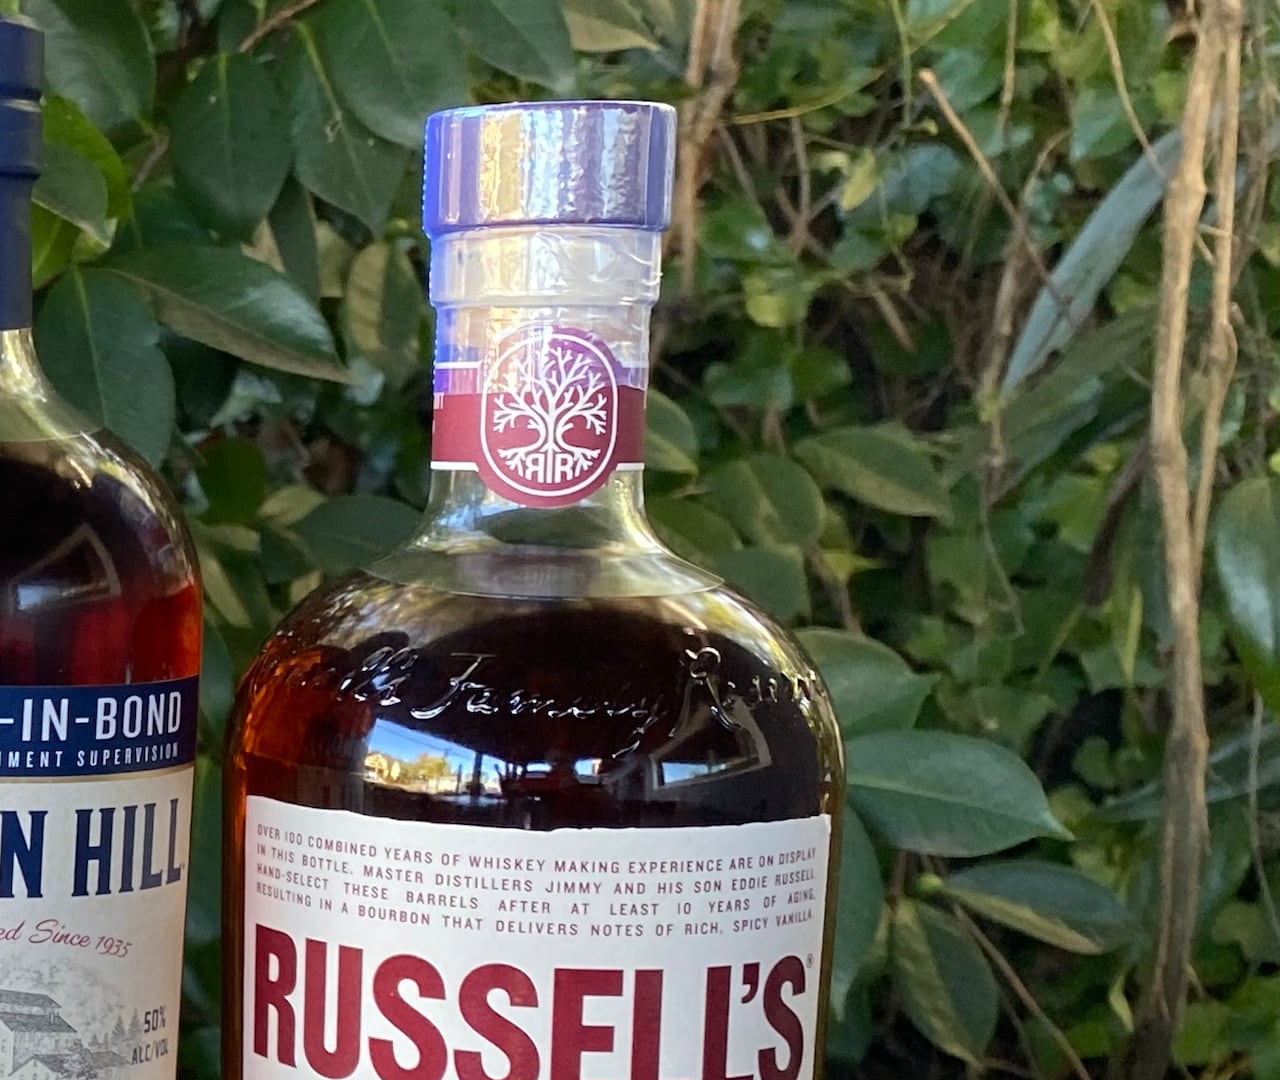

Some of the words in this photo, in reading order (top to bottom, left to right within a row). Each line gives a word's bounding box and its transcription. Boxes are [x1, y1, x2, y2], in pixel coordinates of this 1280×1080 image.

[77, 741, 179, 767] SUPERVISION
[71, 798, 182, 897] HILL
[257, 823, 280, 841] OVER
[285, 831, 302, 846] 100
[308, 836, 377, 858] COMBINED
[384, 847, 433, 865] YEARS
[441, 853, 460, 866] OF
[469, 857, 545, 872] WHISKEY
[554, 860, 620, 874] MAKING
[628, 859, 723, 874] EXPERIENCE
[729, 856, 753, 871] ARE
[759, 855, 774, 868] ON
[779, 847, 817, 865] DISPLAY
[257, 843, 266, 857] IN
[271, 847, 295, 864] THIS
[302, 854, 353, 875] BOTTLE.
[363, 865, 424, 884] MASTER
[435, 873, 533, 893] DISTILLERS
[545, 881, 602, 895] JIMMY
[613, 882, 645, 895] AND
[657, 882, 683, 895] HIS
[694, 880, 722, 894] SON
[731, 876, 768, 891] EDDIE
[256, 863, 329, 890] HAND-SELECT
[344, 881, 389, 900] THESE
[406, 891, 479, 910] BARRELS
[498, 900, 550, 914] AFTER
[570, 903, 590, 916] AT
[610, 903, 659, 916] LEAST
[677, 902, 691, 916] 10
[708, 898, 751, 914] YEARS
[763, 896, 777, 909] OF
[256, 882, 312, 908] RESULTING
[319, 898, 332, 911] IN
[341, 903, 349, 914] A
[358, 905, 431, 925] BOURBON
[442, 916, 483, 931] THAT
[495, 920, 579, 936] DELIVERS
[590, 924, 644, 937] NOTES
[655, 923, 674, 936] OF
[732, 917, 769, 933] SPICY
[29, 919, 91, 948] Since
[95, 936, 133, 958] 1935
[143, 1005, 167, 1034] 50%
[131, 1040, 169, 1065] ALC/VOL
